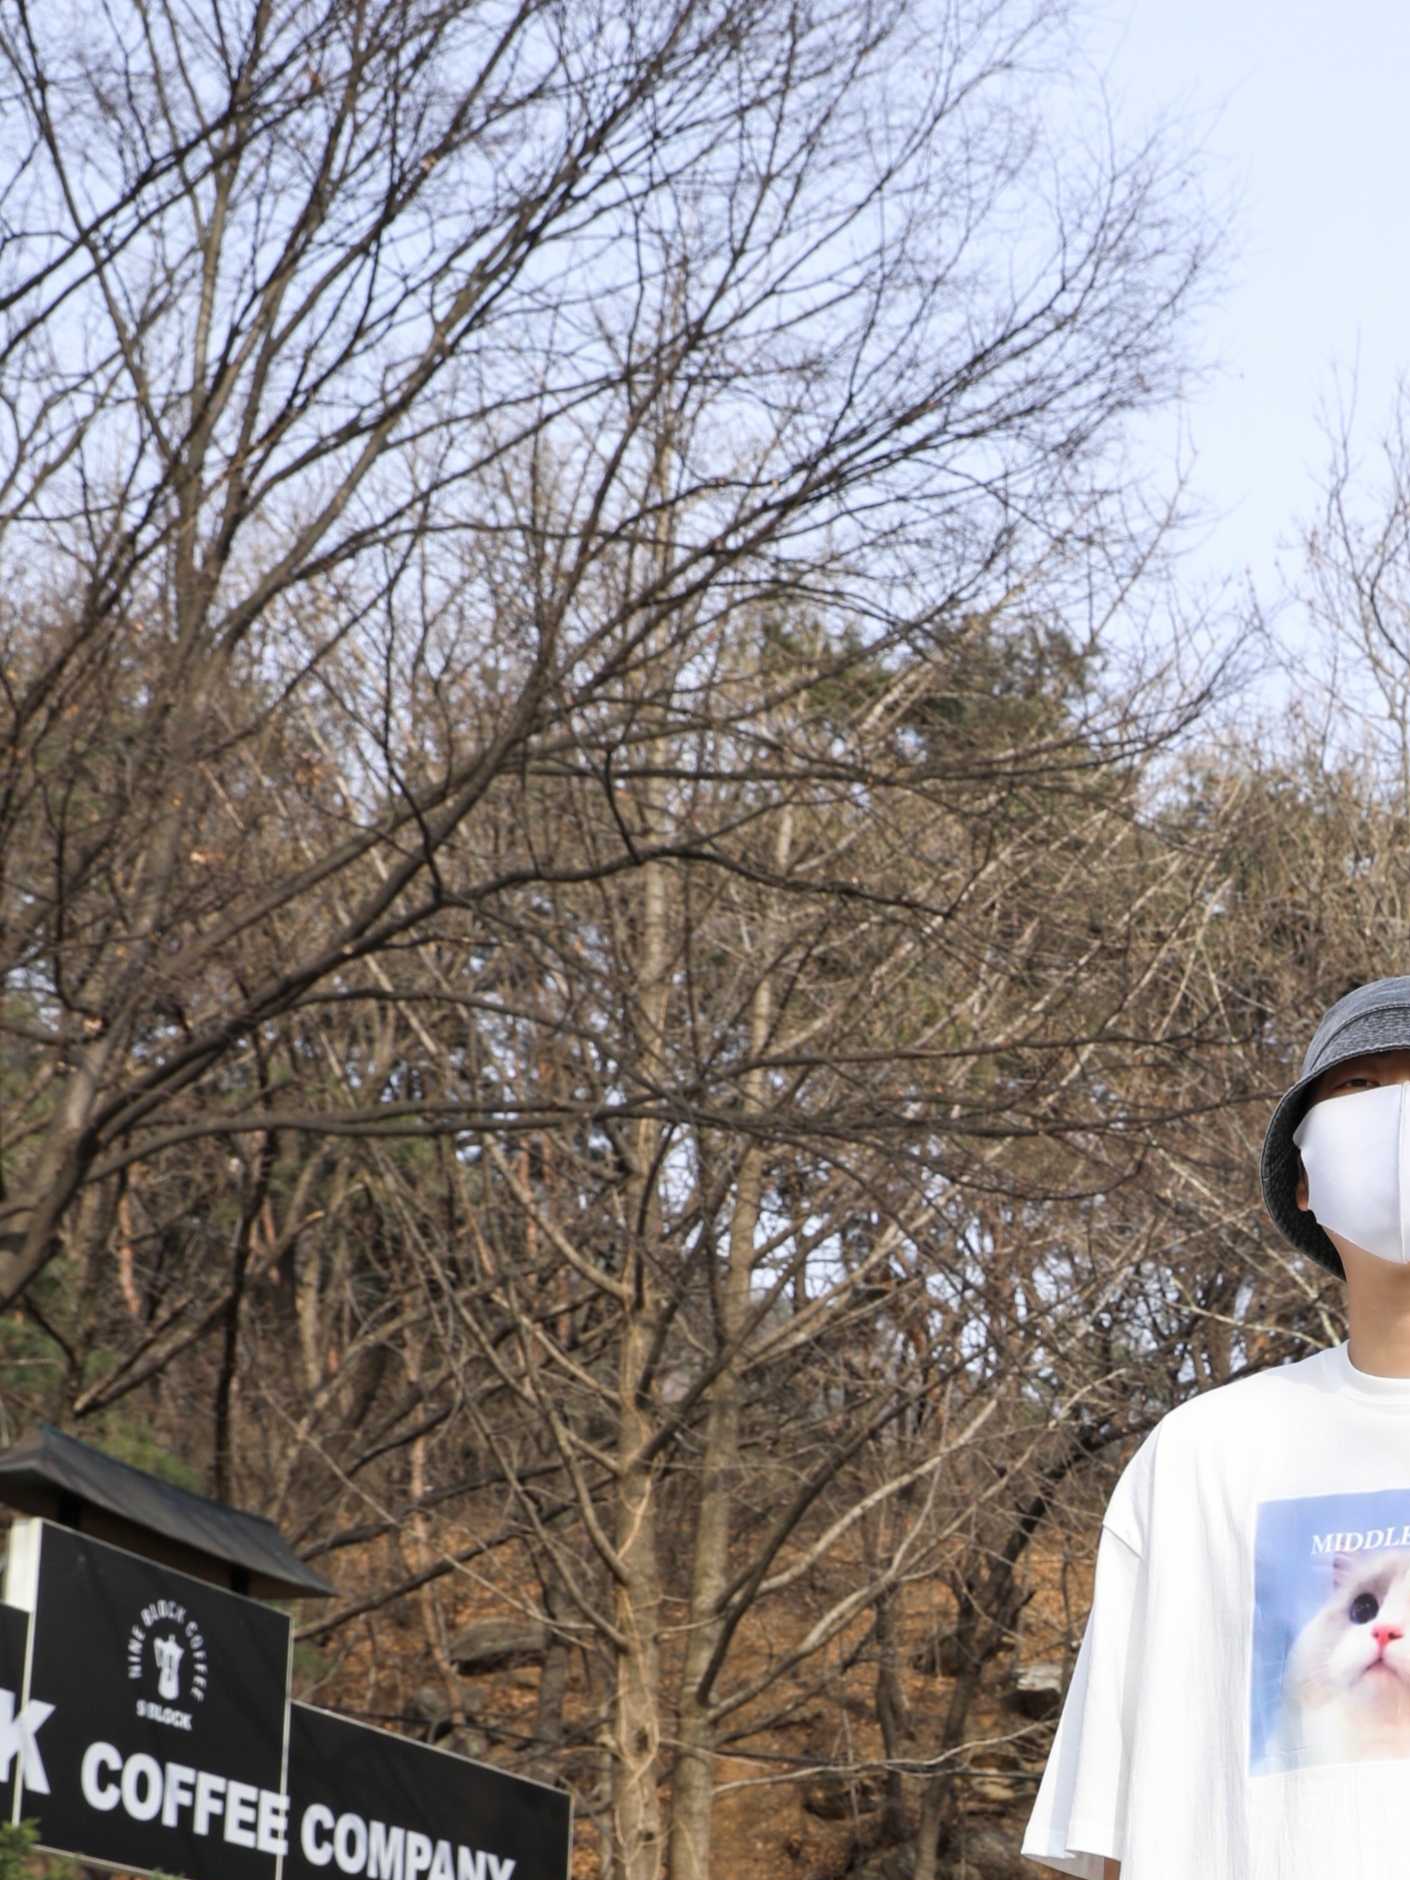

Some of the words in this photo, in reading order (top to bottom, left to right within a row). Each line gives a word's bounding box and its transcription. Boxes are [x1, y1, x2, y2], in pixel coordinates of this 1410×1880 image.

[127, 1624, 146, 1679] NINE
[140, 1599, 187, 1628] BLOCK
[185, 1621, 208, 1702] COFFEE
[81, 1741, 290, 1856] COFFEE
